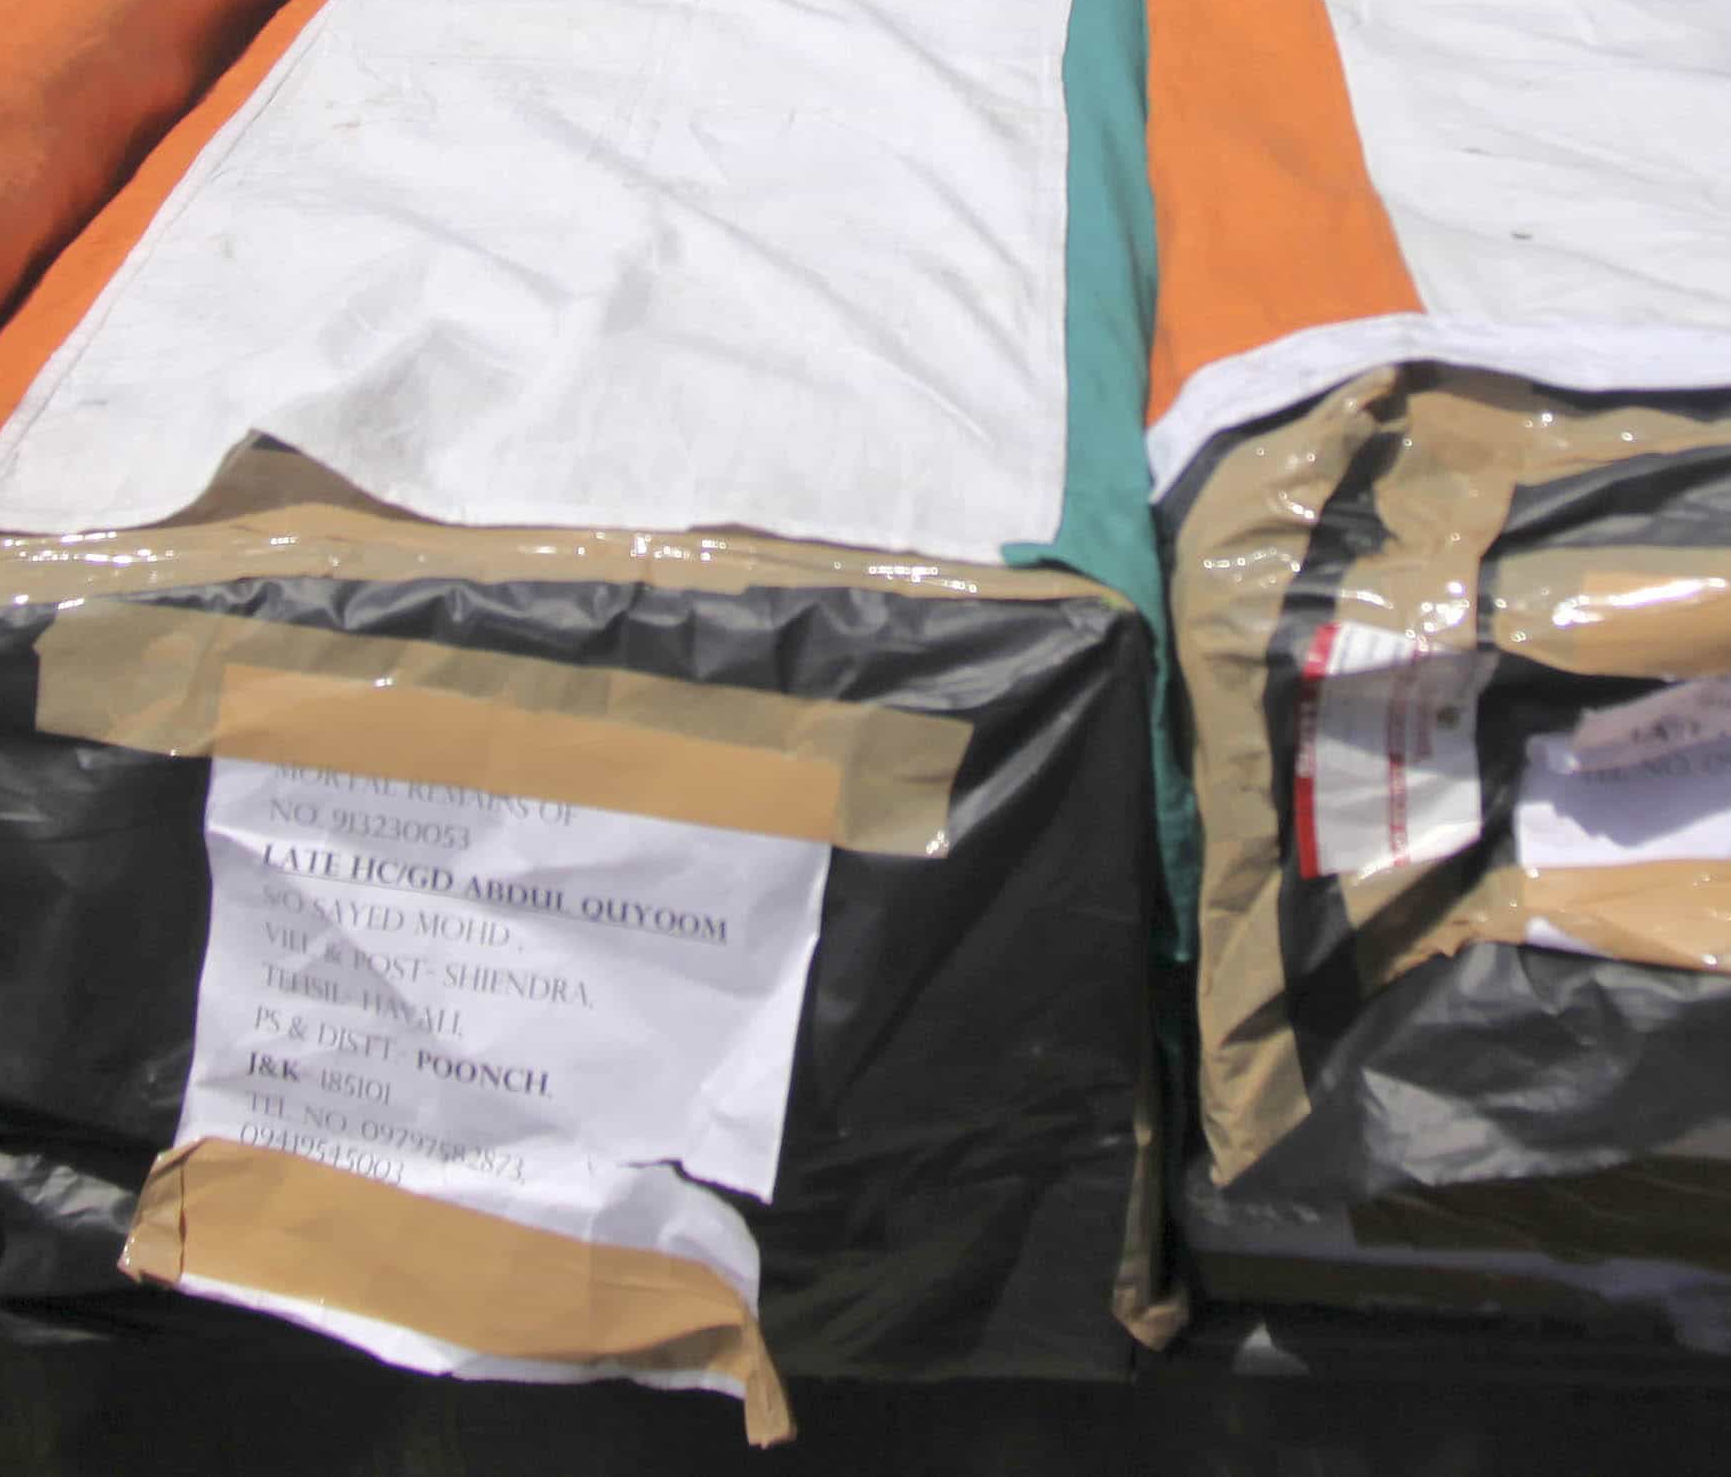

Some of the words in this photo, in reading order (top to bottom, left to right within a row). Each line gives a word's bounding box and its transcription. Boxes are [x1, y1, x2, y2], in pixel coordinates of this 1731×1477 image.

[263, 843, 339, 876] LATE
[351, 854, 454, 892] HC/GD
[465, 874, 567, 913] ABDUL
[580, 896, 726, 941] QUYOOM
[313, 896, 406, 932] SAYED
[254, 1005, 281, 1033] PS
[287, 1015, 307, 1041] &
[320, 1068, 392, 1106] 185101
